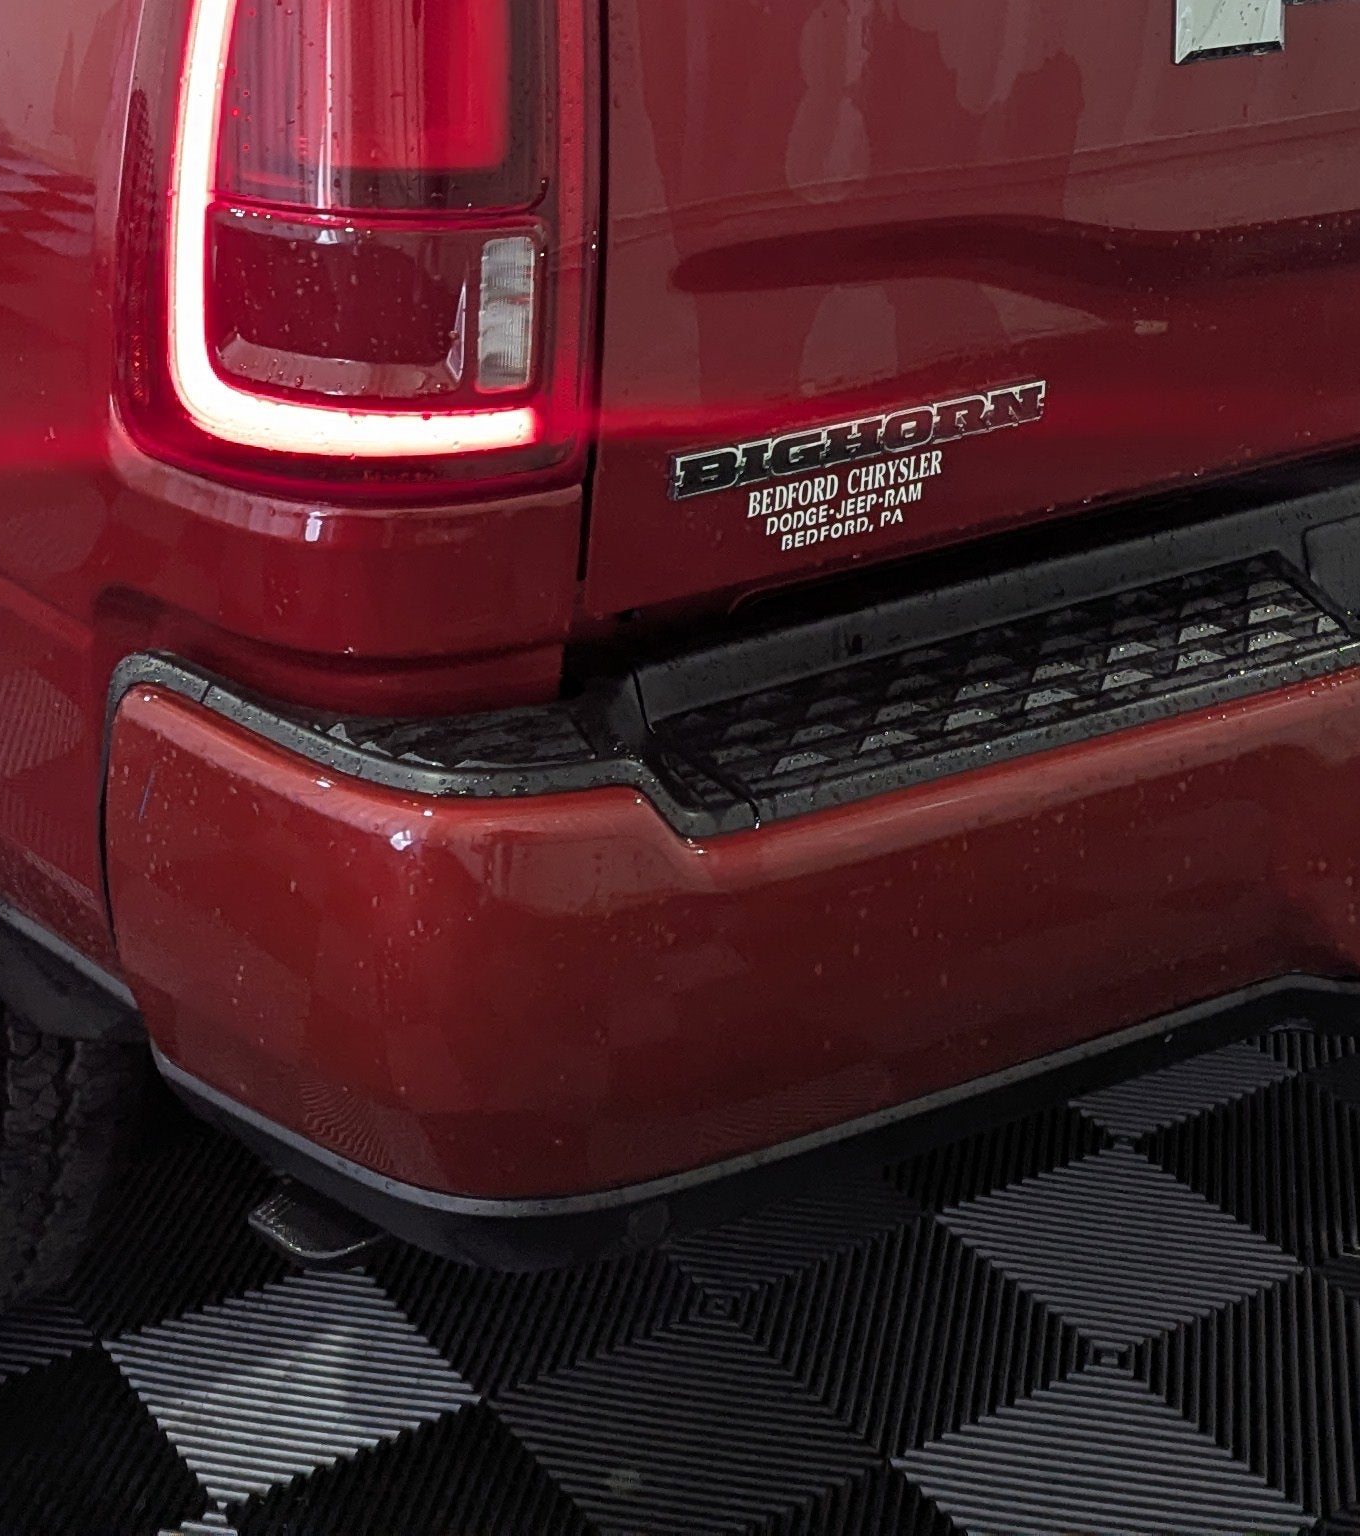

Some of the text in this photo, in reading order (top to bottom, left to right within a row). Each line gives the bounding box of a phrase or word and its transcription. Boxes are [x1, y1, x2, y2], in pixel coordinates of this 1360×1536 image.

[747, 450, 942, 519] BEDFORD CHRYSLER
[781, 509, 903, 551] BEDFORD, PA
